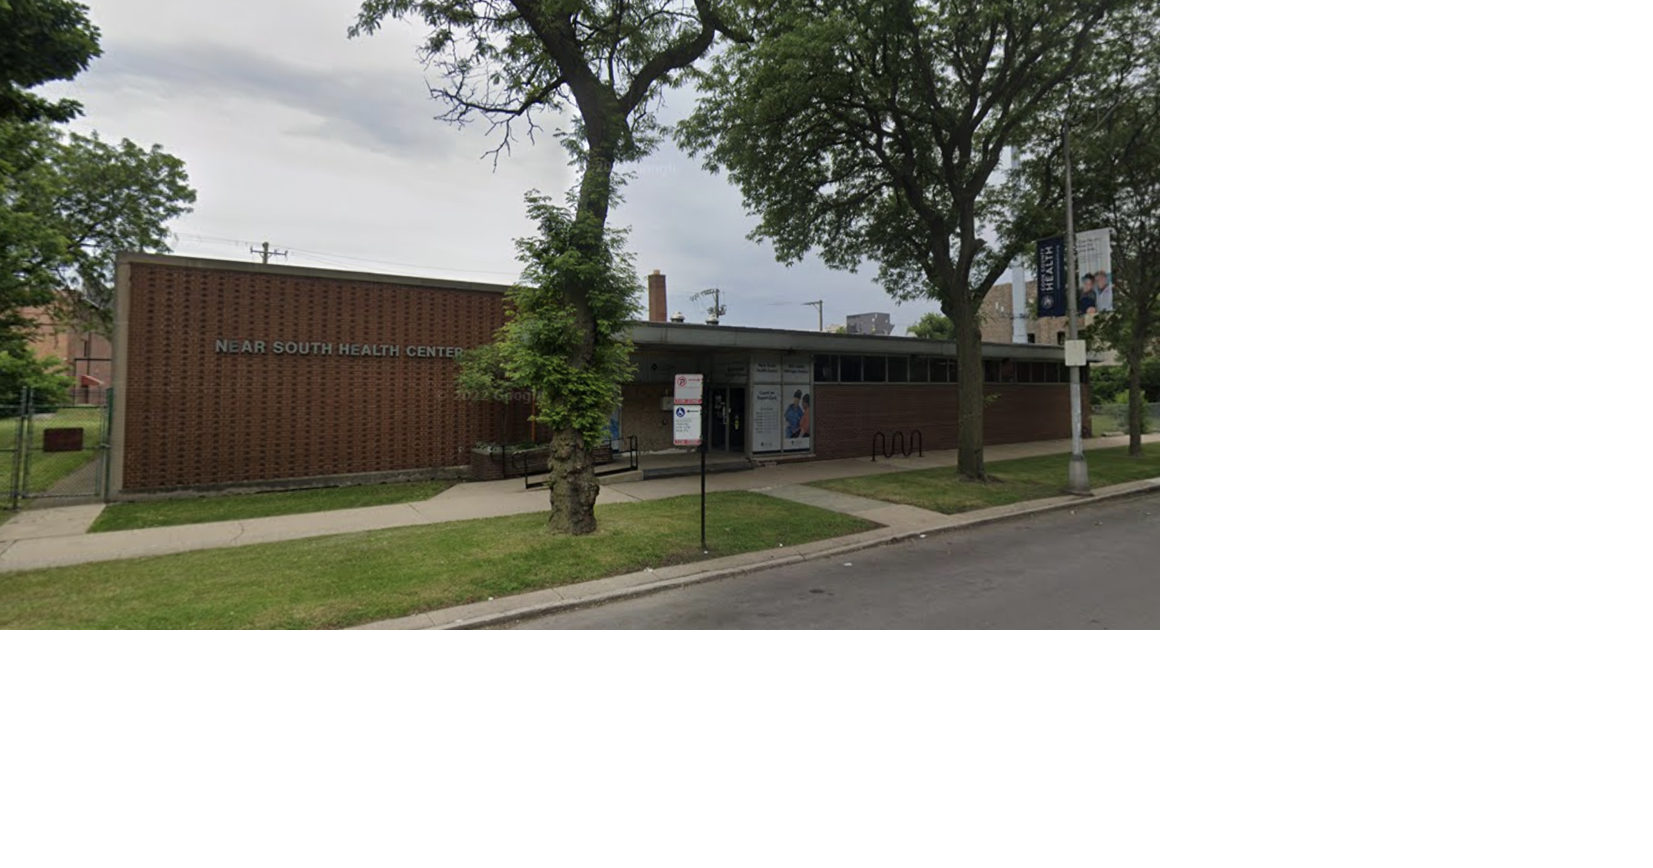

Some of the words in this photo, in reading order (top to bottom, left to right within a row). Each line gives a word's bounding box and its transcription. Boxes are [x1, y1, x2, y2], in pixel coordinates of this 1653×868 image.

[1045, 246, 1054, 291] HEALTH
[215, 339, 266, 354] NEAR
[272, 341, 333, 356] SOUTH
[338, 344, 400, 357] HEALTH
[405, 345, 464, 359] CENTER
